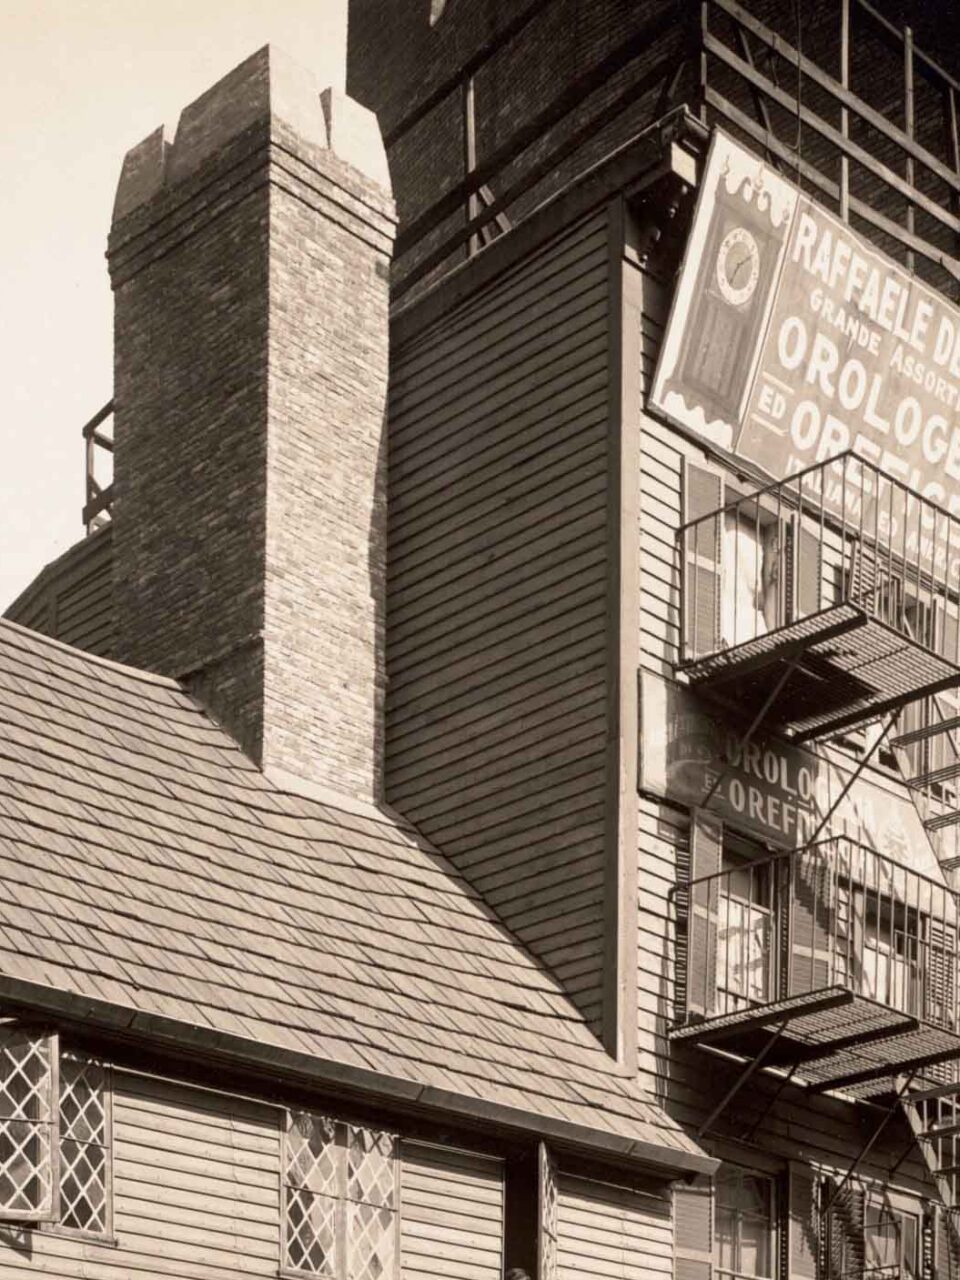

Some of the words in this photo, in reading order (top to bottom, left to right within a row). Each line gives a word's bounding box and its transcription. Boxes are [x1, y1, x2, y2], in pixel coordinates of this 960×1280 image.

[792, 212, 933, 353] RAFFAELE
[758, 385, 786, 420] ED
[810, 288, 882, 357] GRANDE
[890, 343, 960, 413] ASSORT
